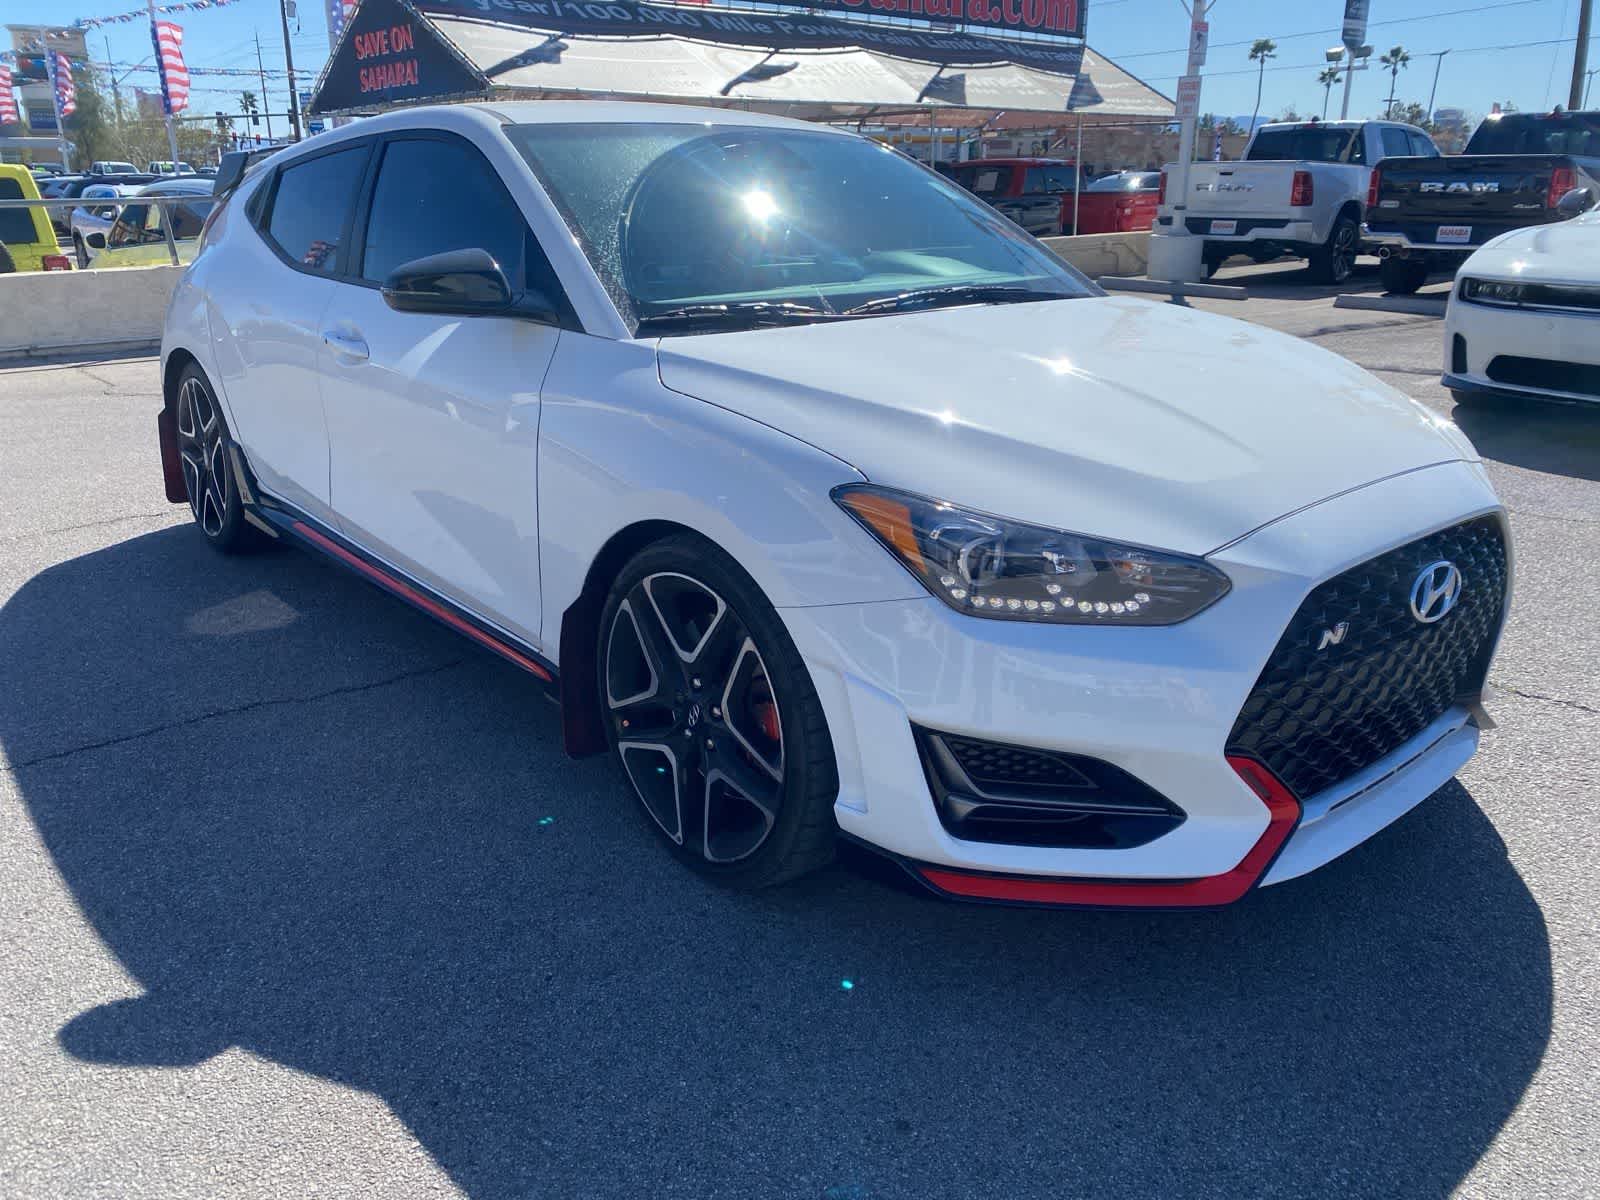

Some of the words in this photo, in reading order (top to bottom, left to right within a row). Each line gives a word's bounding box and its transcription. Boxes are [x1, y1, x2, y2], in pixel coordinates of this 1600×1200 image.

[703, 14, 774, 34] Mile
[355, 28, 389, 60] SAVE
[390, 23, 414, 52] ON
[360, 59, 418, 93] SAHARA!
[1419, 182, 1500, 192] RAM
